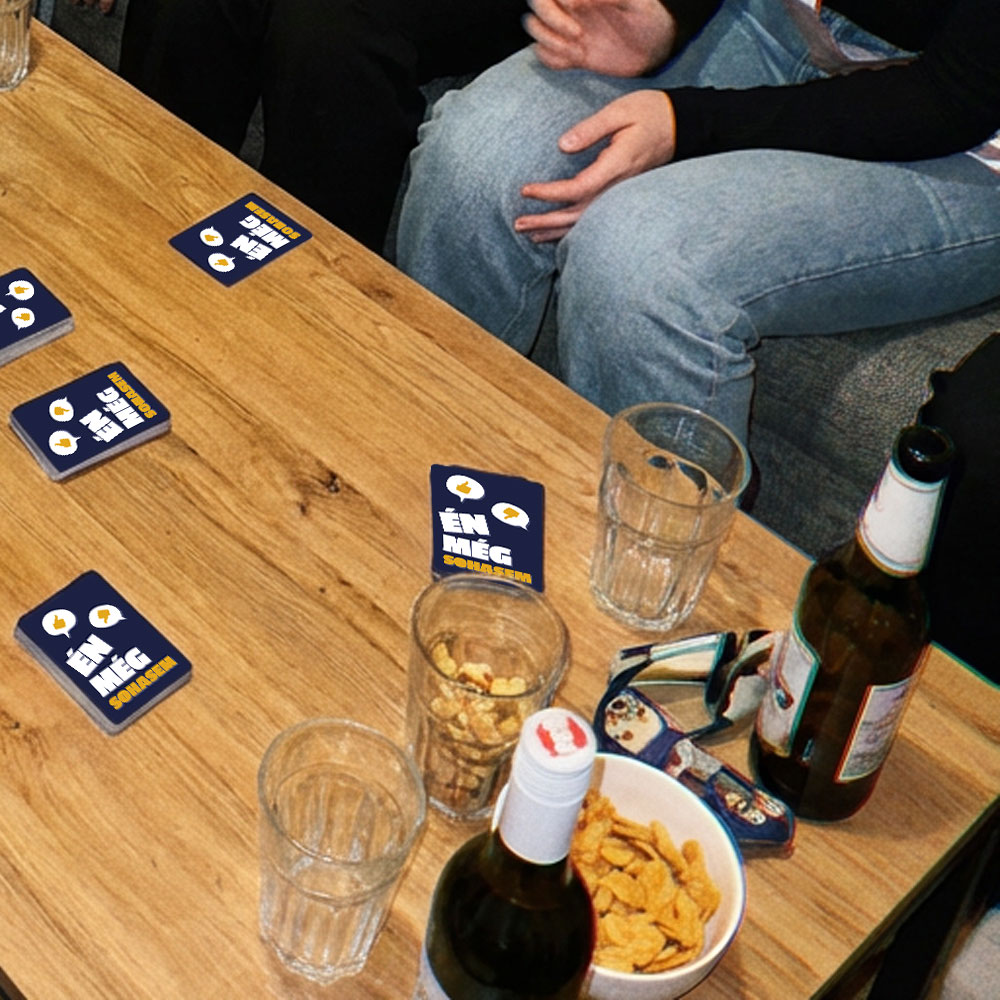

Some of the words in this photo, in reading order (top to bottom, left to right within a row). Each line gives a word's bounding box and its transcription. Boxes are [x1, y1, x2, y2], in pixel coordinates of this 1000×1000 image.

[238, 214, 291, 249] MÉG
[244, 201, 301, 239] SOHASEM
[230, 234, 273, 261] ÉN
[96, 386, 145, 429] MÉG
[107, 371, 157, 419] SOHASEM
[78, 408, 124, 443] ÉN
[438, 507, 491, 536] ÉN
[442, 534, 512, 567] MÉG
[443, 554, 532, 584] SOHASEM
[66, 633, 114, 678] ÉN
[89, 647, 153, 698] MÉG
[108, 655, 178, 710] SOHASEM
